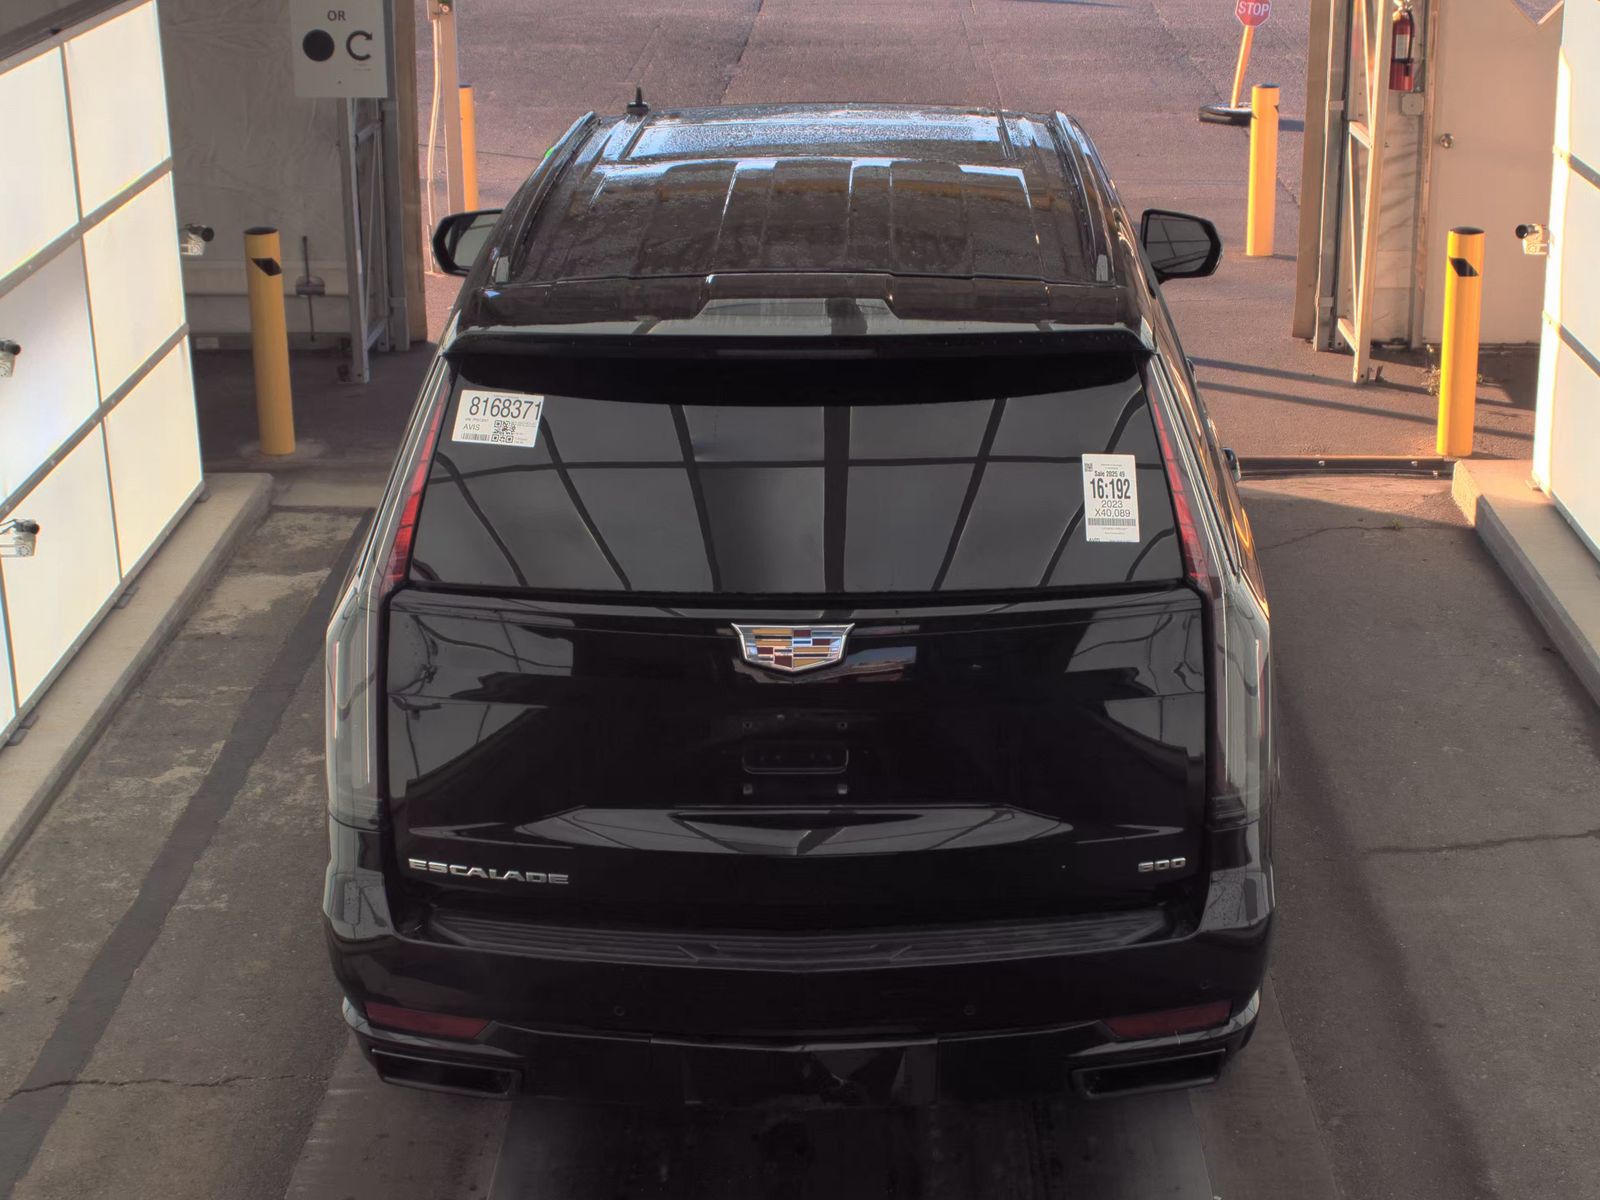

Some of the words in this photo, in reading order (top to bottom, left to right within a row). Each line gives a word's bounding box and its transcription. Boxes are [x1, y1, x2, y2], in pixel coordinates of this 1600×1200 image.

[327, 9, 346, 21] OR
[1238, 1, 1269, 16] STOP
[469, 396, 541, 420] 8168371
[463, 423, 480, 431] AVIS
[1090, 478, 1131, 499] 16:192
[1101, 500, 1123, 508] 2023
[408, 858, 569, 884] ESCALADE
[1138, 857, 1186, 873] 600
